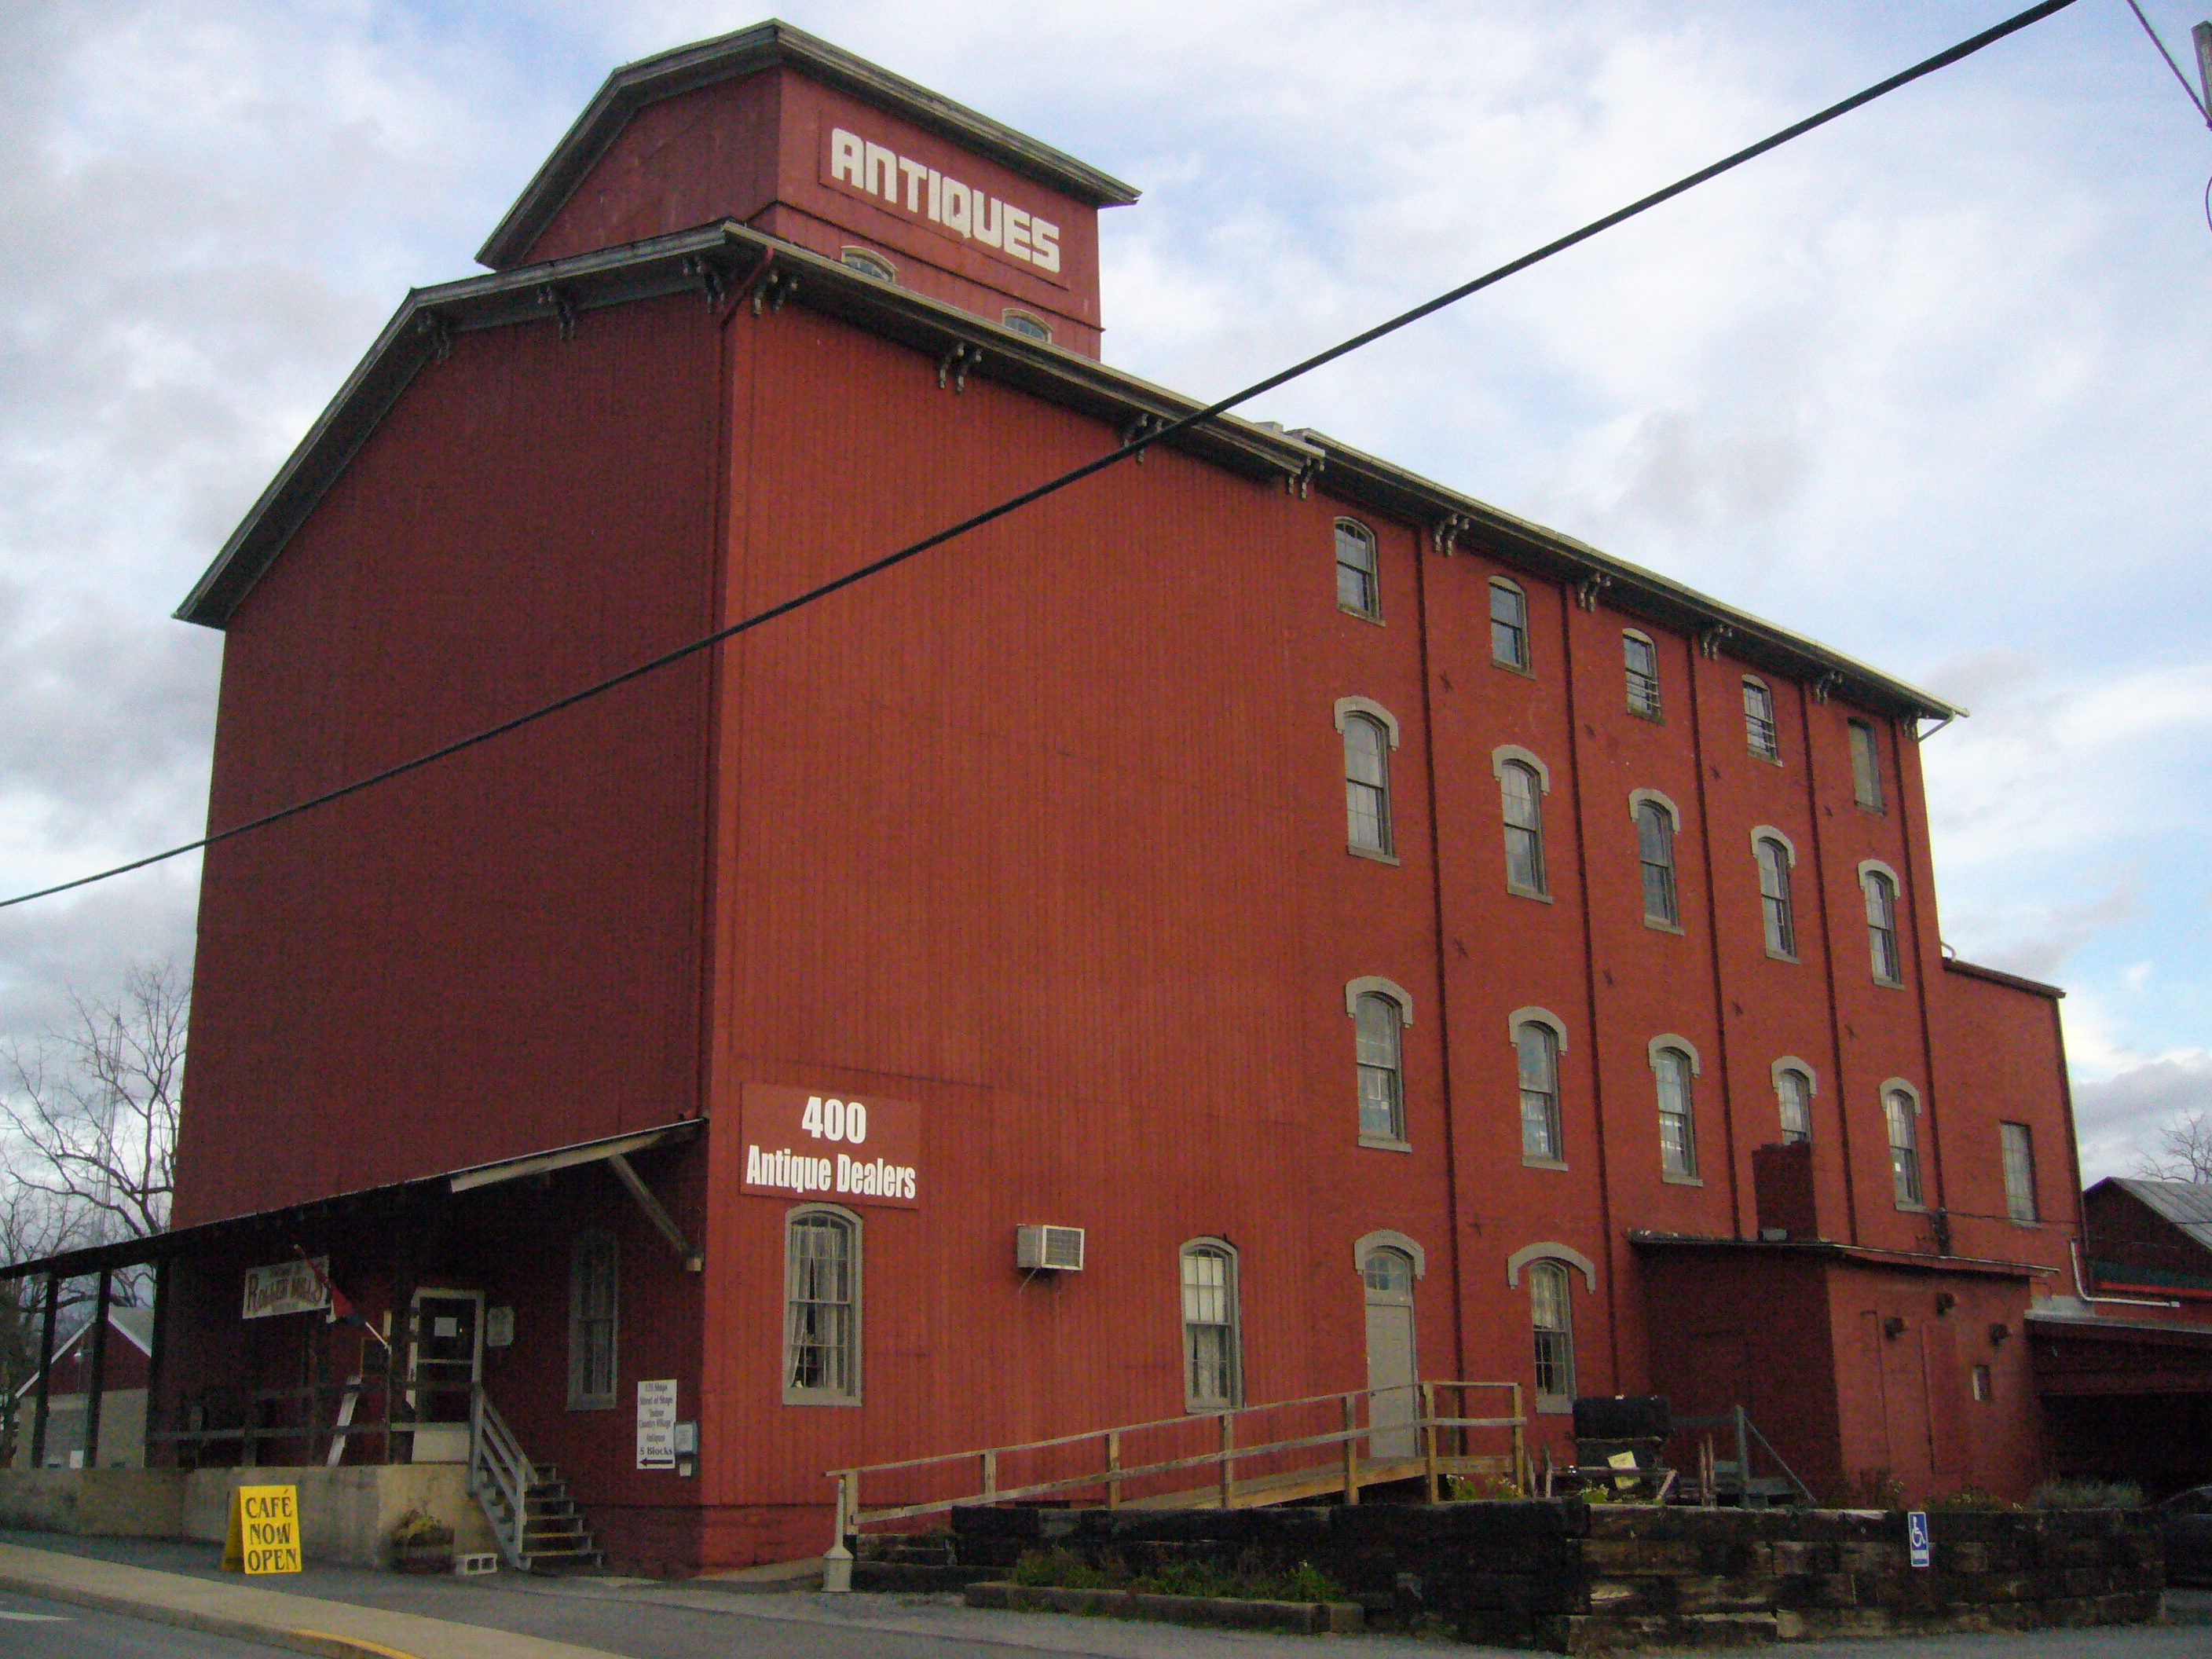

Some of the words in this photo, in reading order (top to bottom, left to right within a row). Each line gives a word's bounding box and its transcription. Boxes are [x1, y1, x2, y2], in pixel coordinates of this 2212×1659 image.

[832, 128, 1060, 273] ANTIQUES
[801, 1096, 867, 1144] 400
[746, 1144, 832, 1192] Antique
[837, 1153, 916, 1199] Dealers
[647, 1446, 673, 1456] Blocks
[245, 1489, 293, 1518] CAFÉ
[250, 1522, 291, 1545] NOW
[248, 1548, 298, 1571] OPEN
